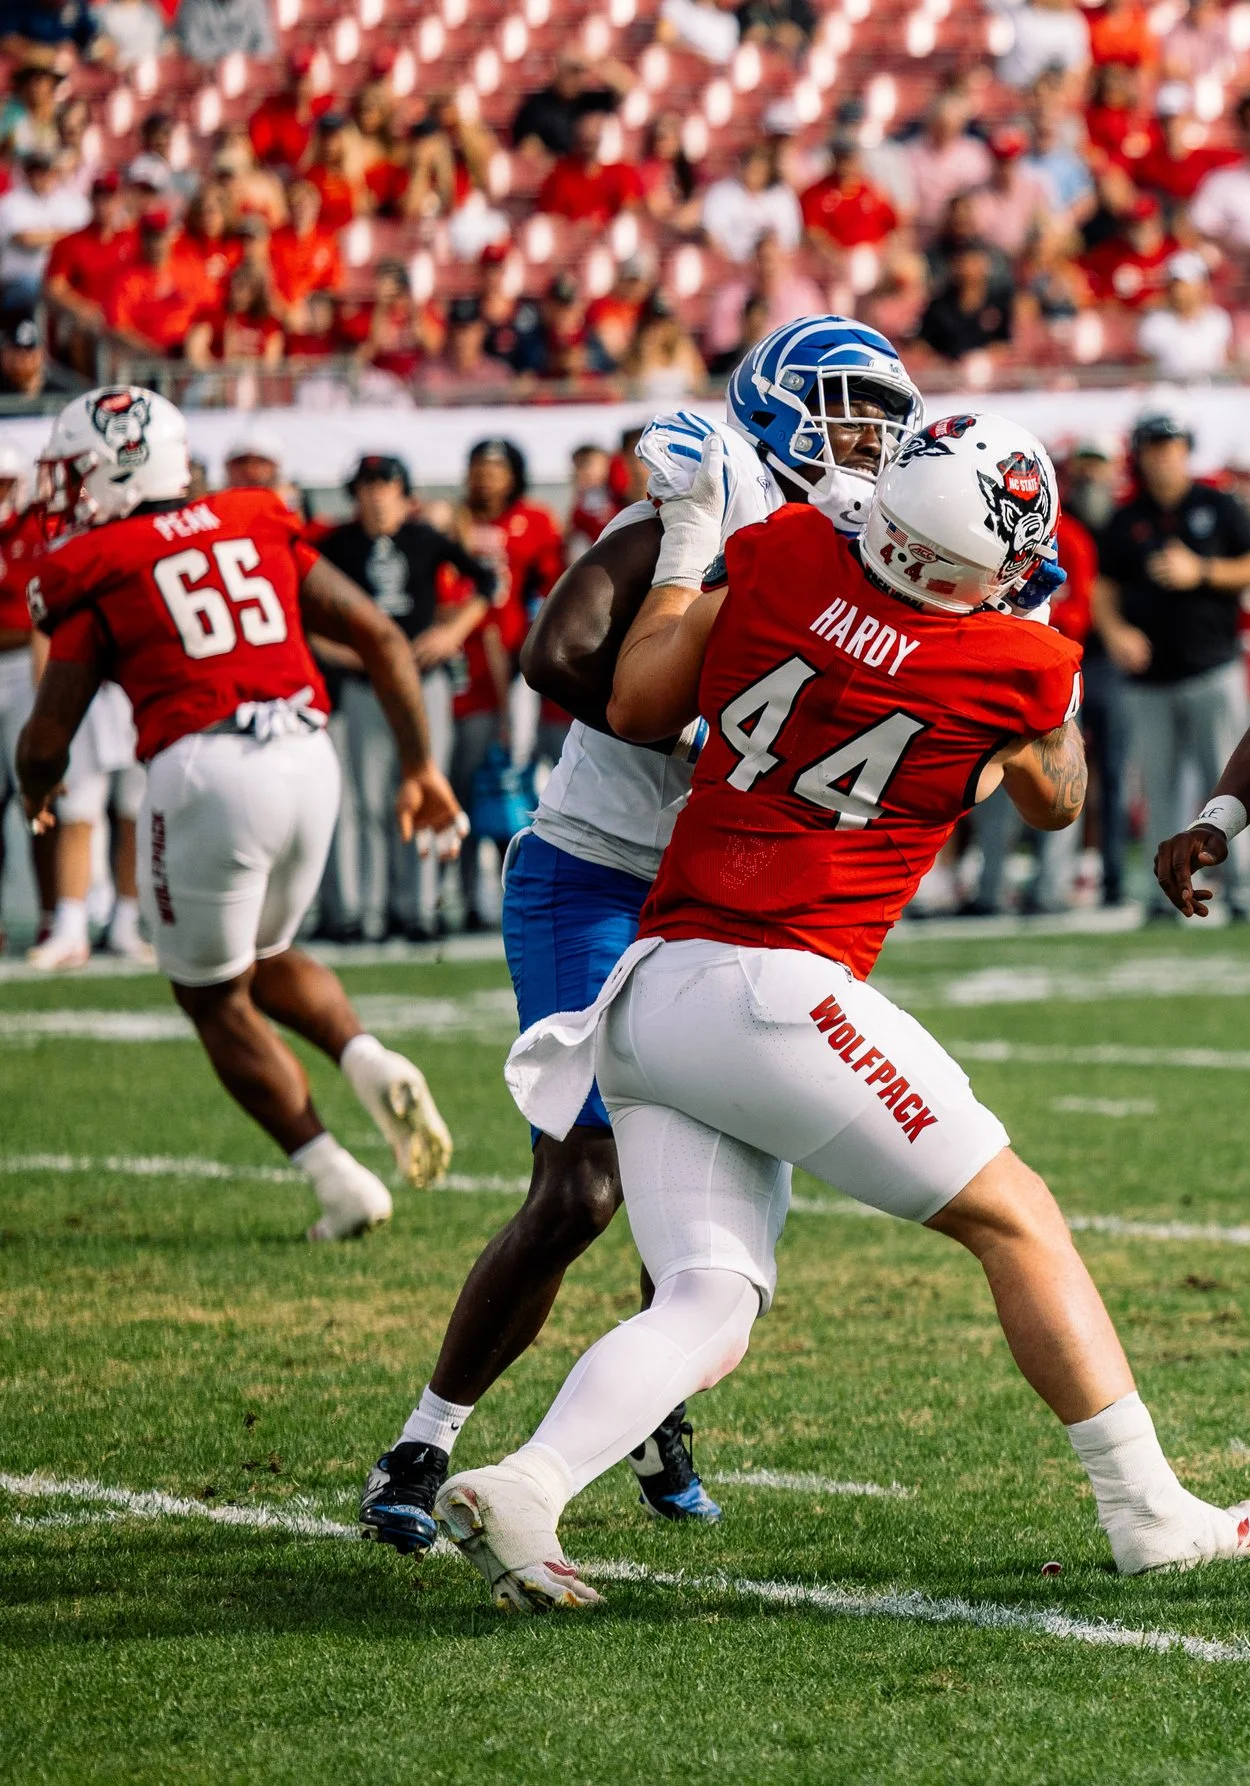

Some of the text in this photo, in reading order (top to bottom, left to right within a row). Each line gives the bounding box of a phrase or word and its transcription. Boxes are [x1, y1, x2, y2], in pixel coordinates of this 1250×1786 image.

[1008, 478, 1039, 492] NC STATE
[153, 537, 287, 660] 65
[910, 547, 935, 561] ACC
[809, 596, 921, 677] HARDY
[719, 655, 928, 831] 44
[809, 994, 939, 1144] WOLFPACK
